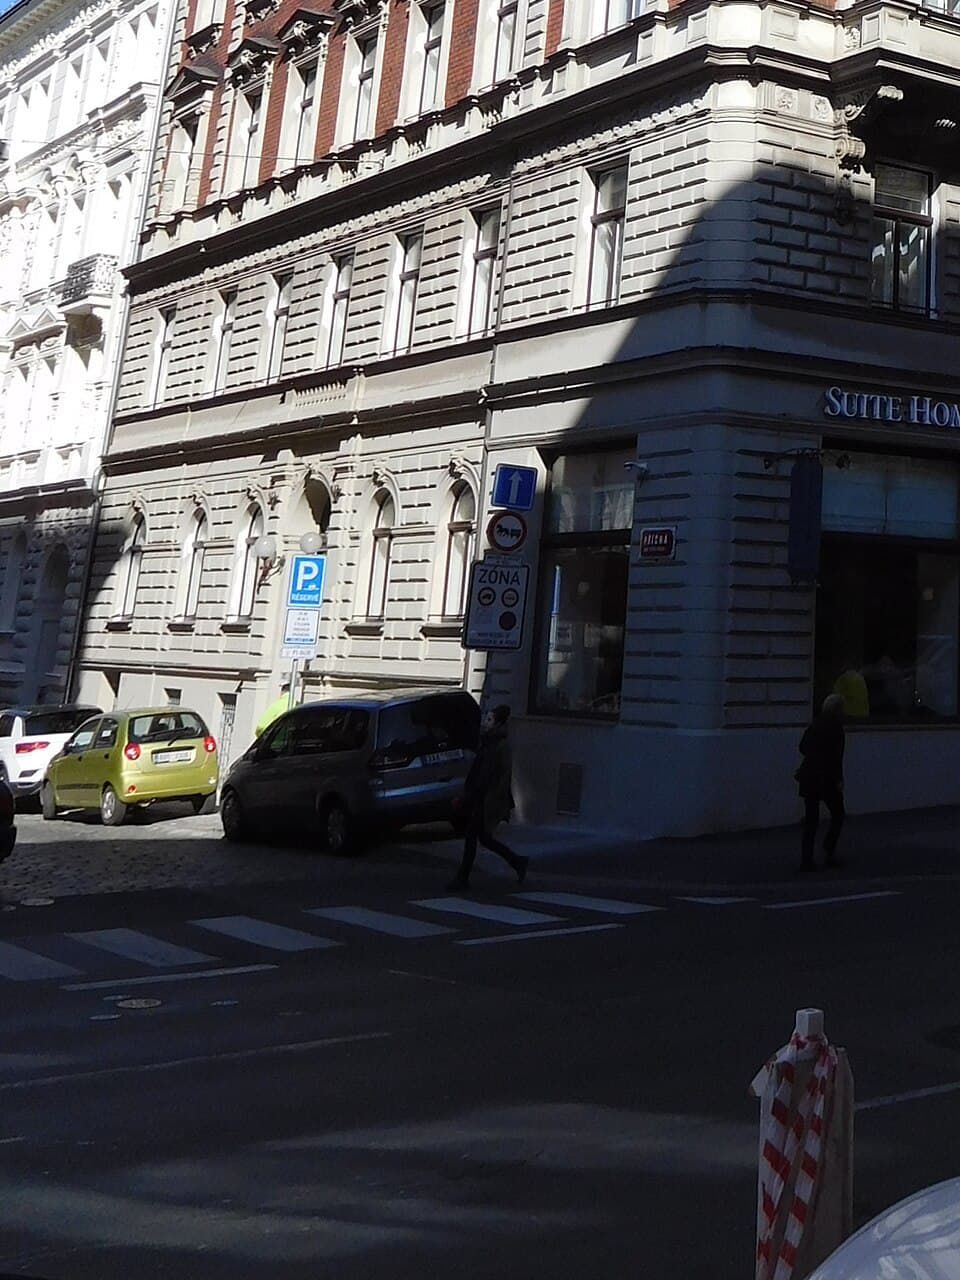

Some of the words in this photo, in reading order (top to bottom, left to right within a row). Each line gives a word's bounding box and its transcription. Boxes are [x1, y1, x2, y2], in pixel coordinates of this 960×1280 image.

[824, 386, 902, 422] SUITE
[296, 561, 319, 591] P
[478, 565, 520, 586] ZÓNA
